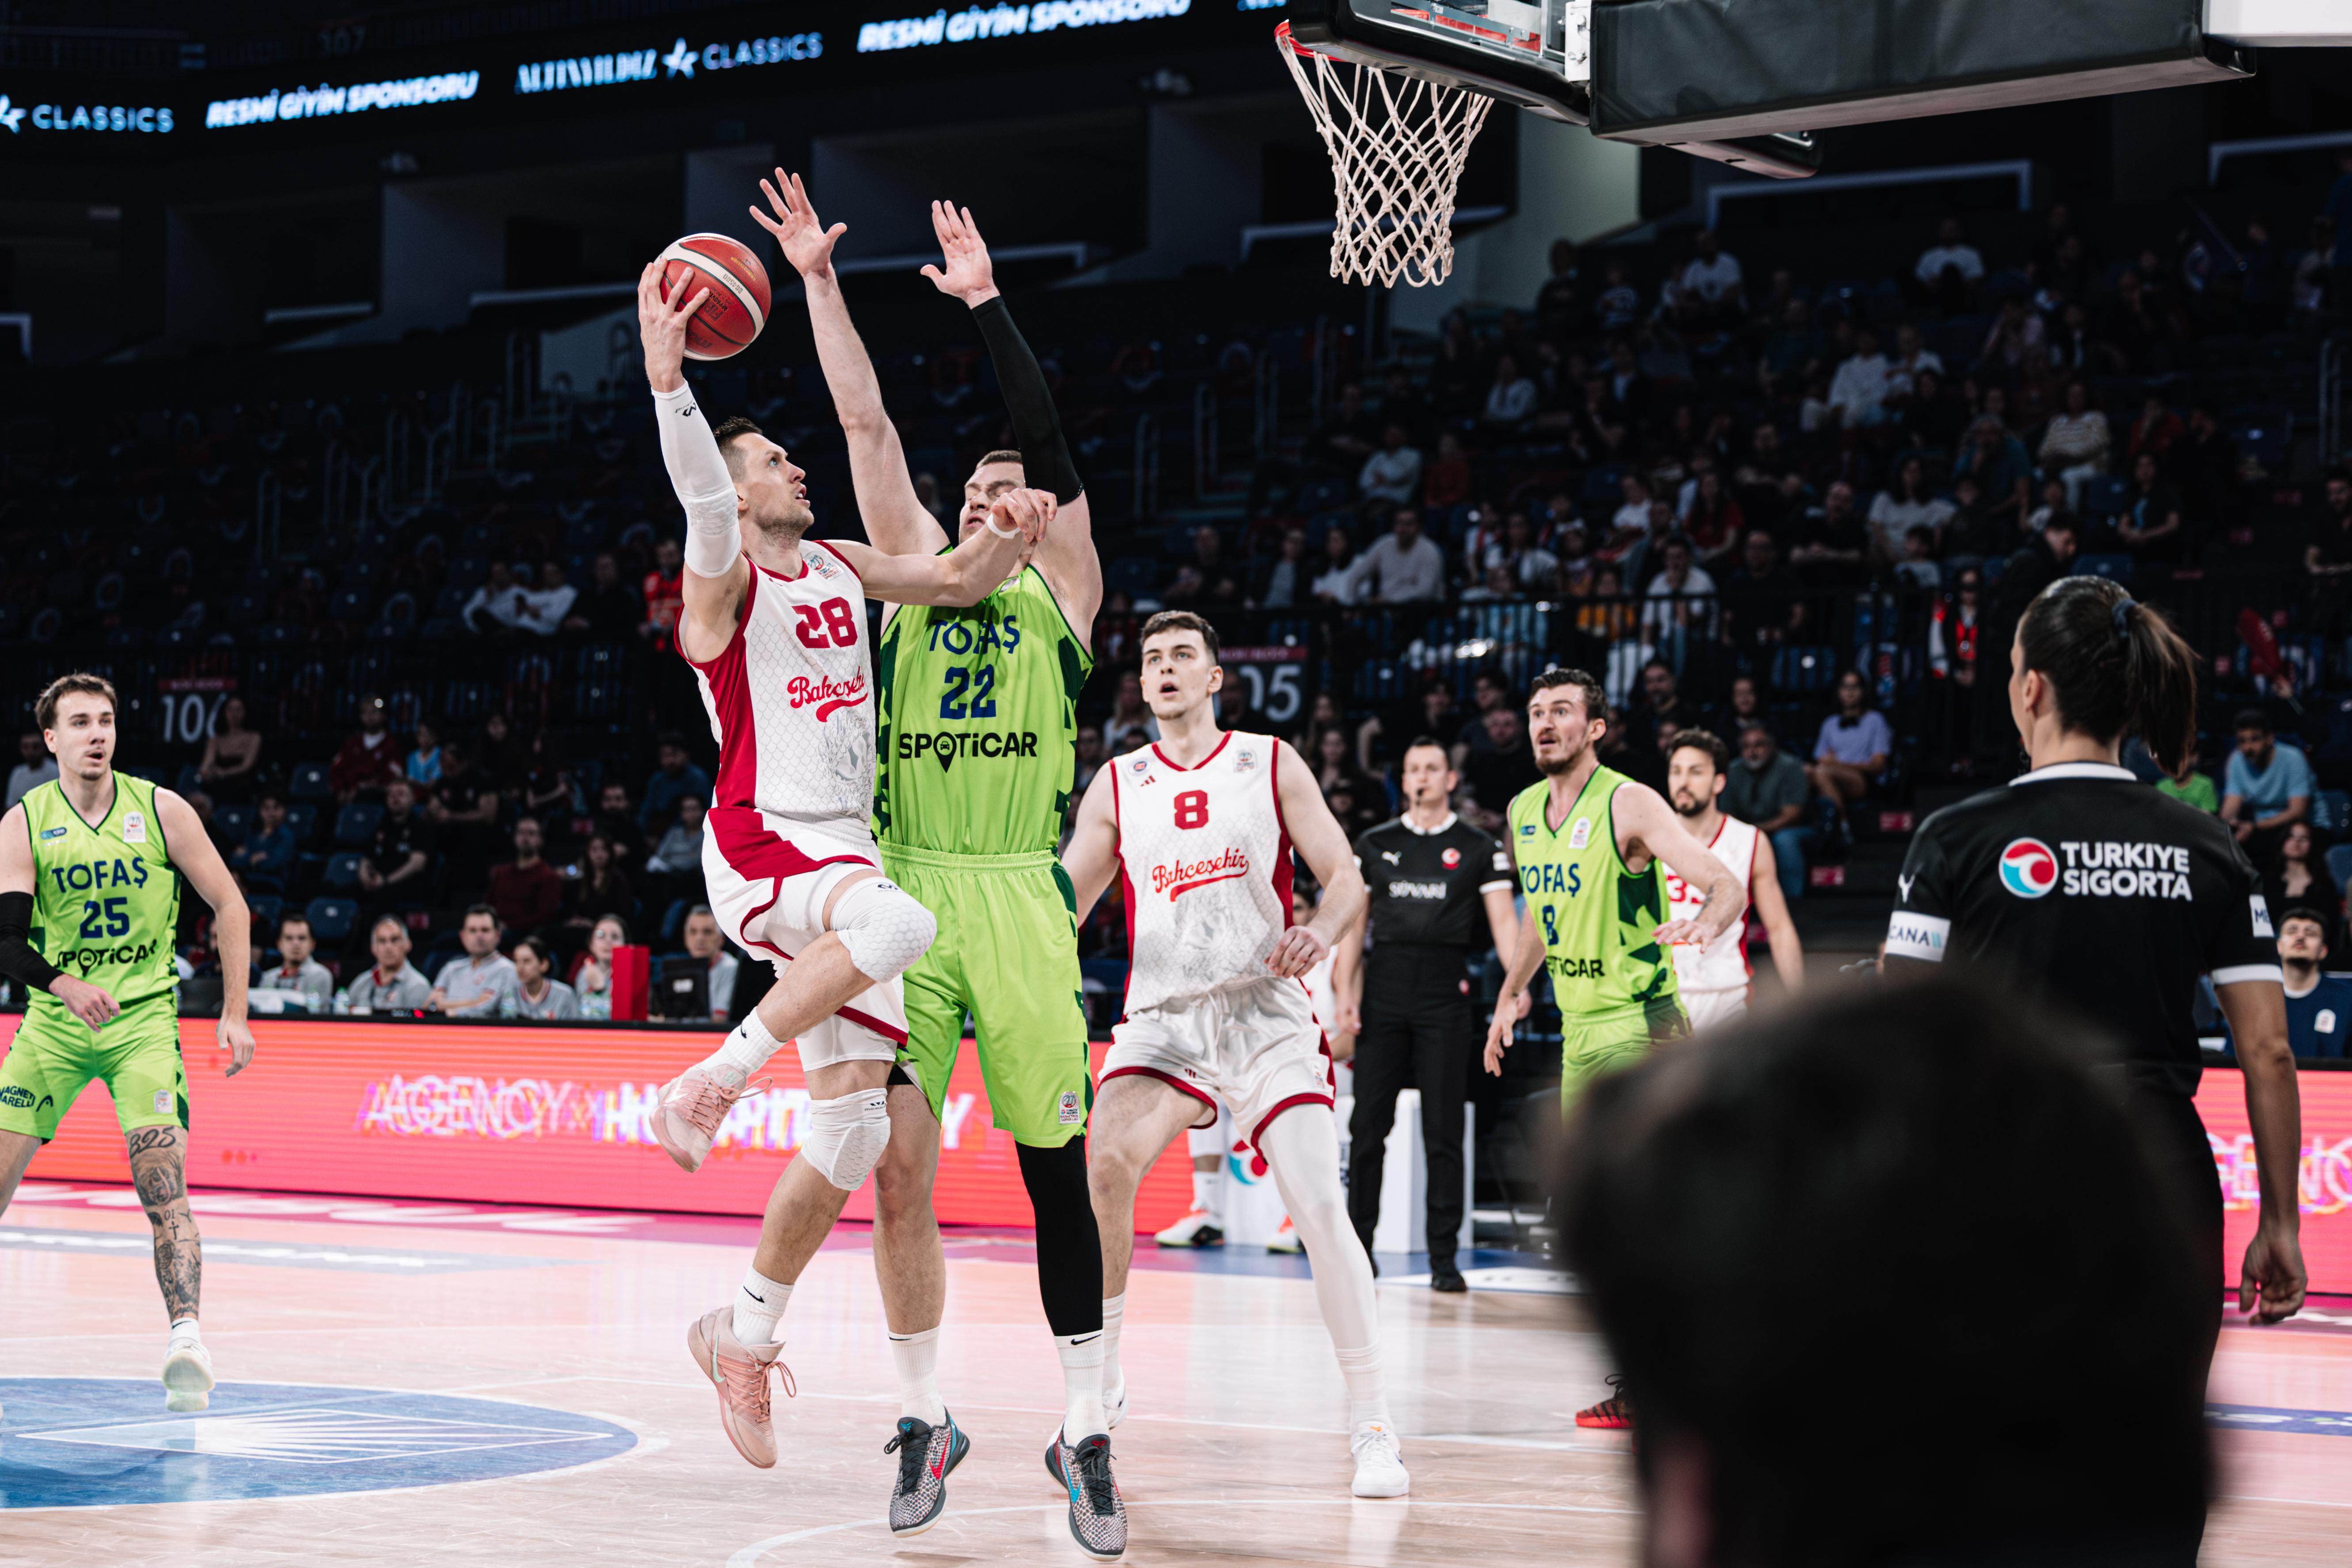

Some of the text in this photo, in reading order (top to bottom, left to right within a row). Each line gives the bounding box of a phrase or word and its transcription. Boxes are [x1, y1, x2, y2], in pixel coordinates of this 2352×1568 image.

[32, 104, 174, 133] CLASSICS
[791, 596, 858, 648] 28
[940, 664, 996, 720] 22
[1174, 790, 1209, 830] 8
[51, 857, 148, 893] TOFAŞ
[80, 896, 130, 939] 25
